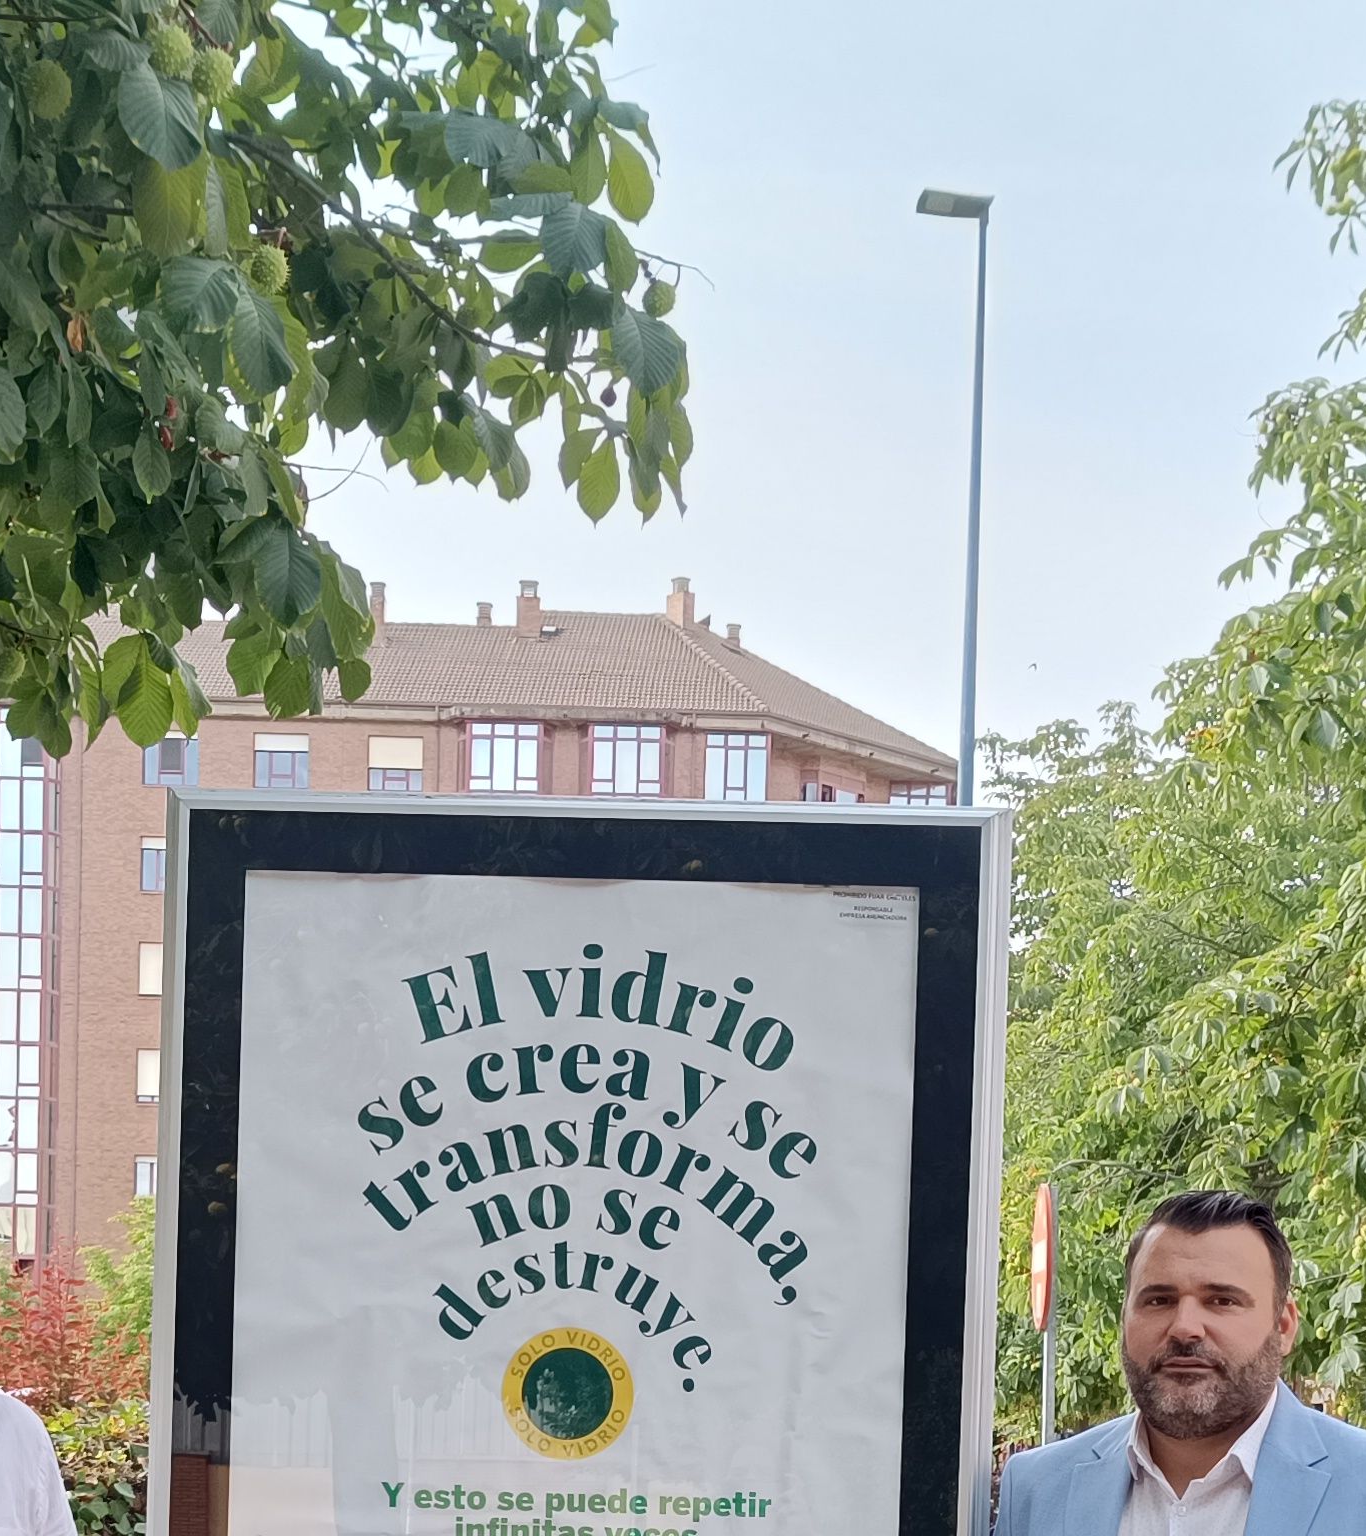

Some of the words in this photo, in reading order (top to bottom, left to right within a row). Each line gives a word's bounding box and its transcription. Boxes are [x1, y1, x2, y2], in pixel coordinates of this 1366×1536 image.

[402, 952, 505, 1044] El
[522, 943, 794, 1072] vidrio
[357, 1075, 443, 1156] se
[466, 1043, 650, 1102] crea
[662, 1062, 727, 1130] y
[727, 1100, 817, 1179] se
[362, 1102, 808, 1306] transforma,
[465, 1183, 571, 1247] no
[595, 1189, 681, 1251] se
[432, 1240, 712, 1393] destruye.
[510, 1333, 556, 1379] SOLO
[566, 1330, 626, 1382] VIDRIO
[508, 1406, 551, 1452] SOLO
[562, 1409, 625, 1457] VIDRIO
[381, 1481, 405, 1508] Y
[413, 1484, 487, 1510] esto
[497, 1491, 534, 1512] se
[545, 1488, 648, 1519] puede
[659, 1491, 772, 1523] repetir
